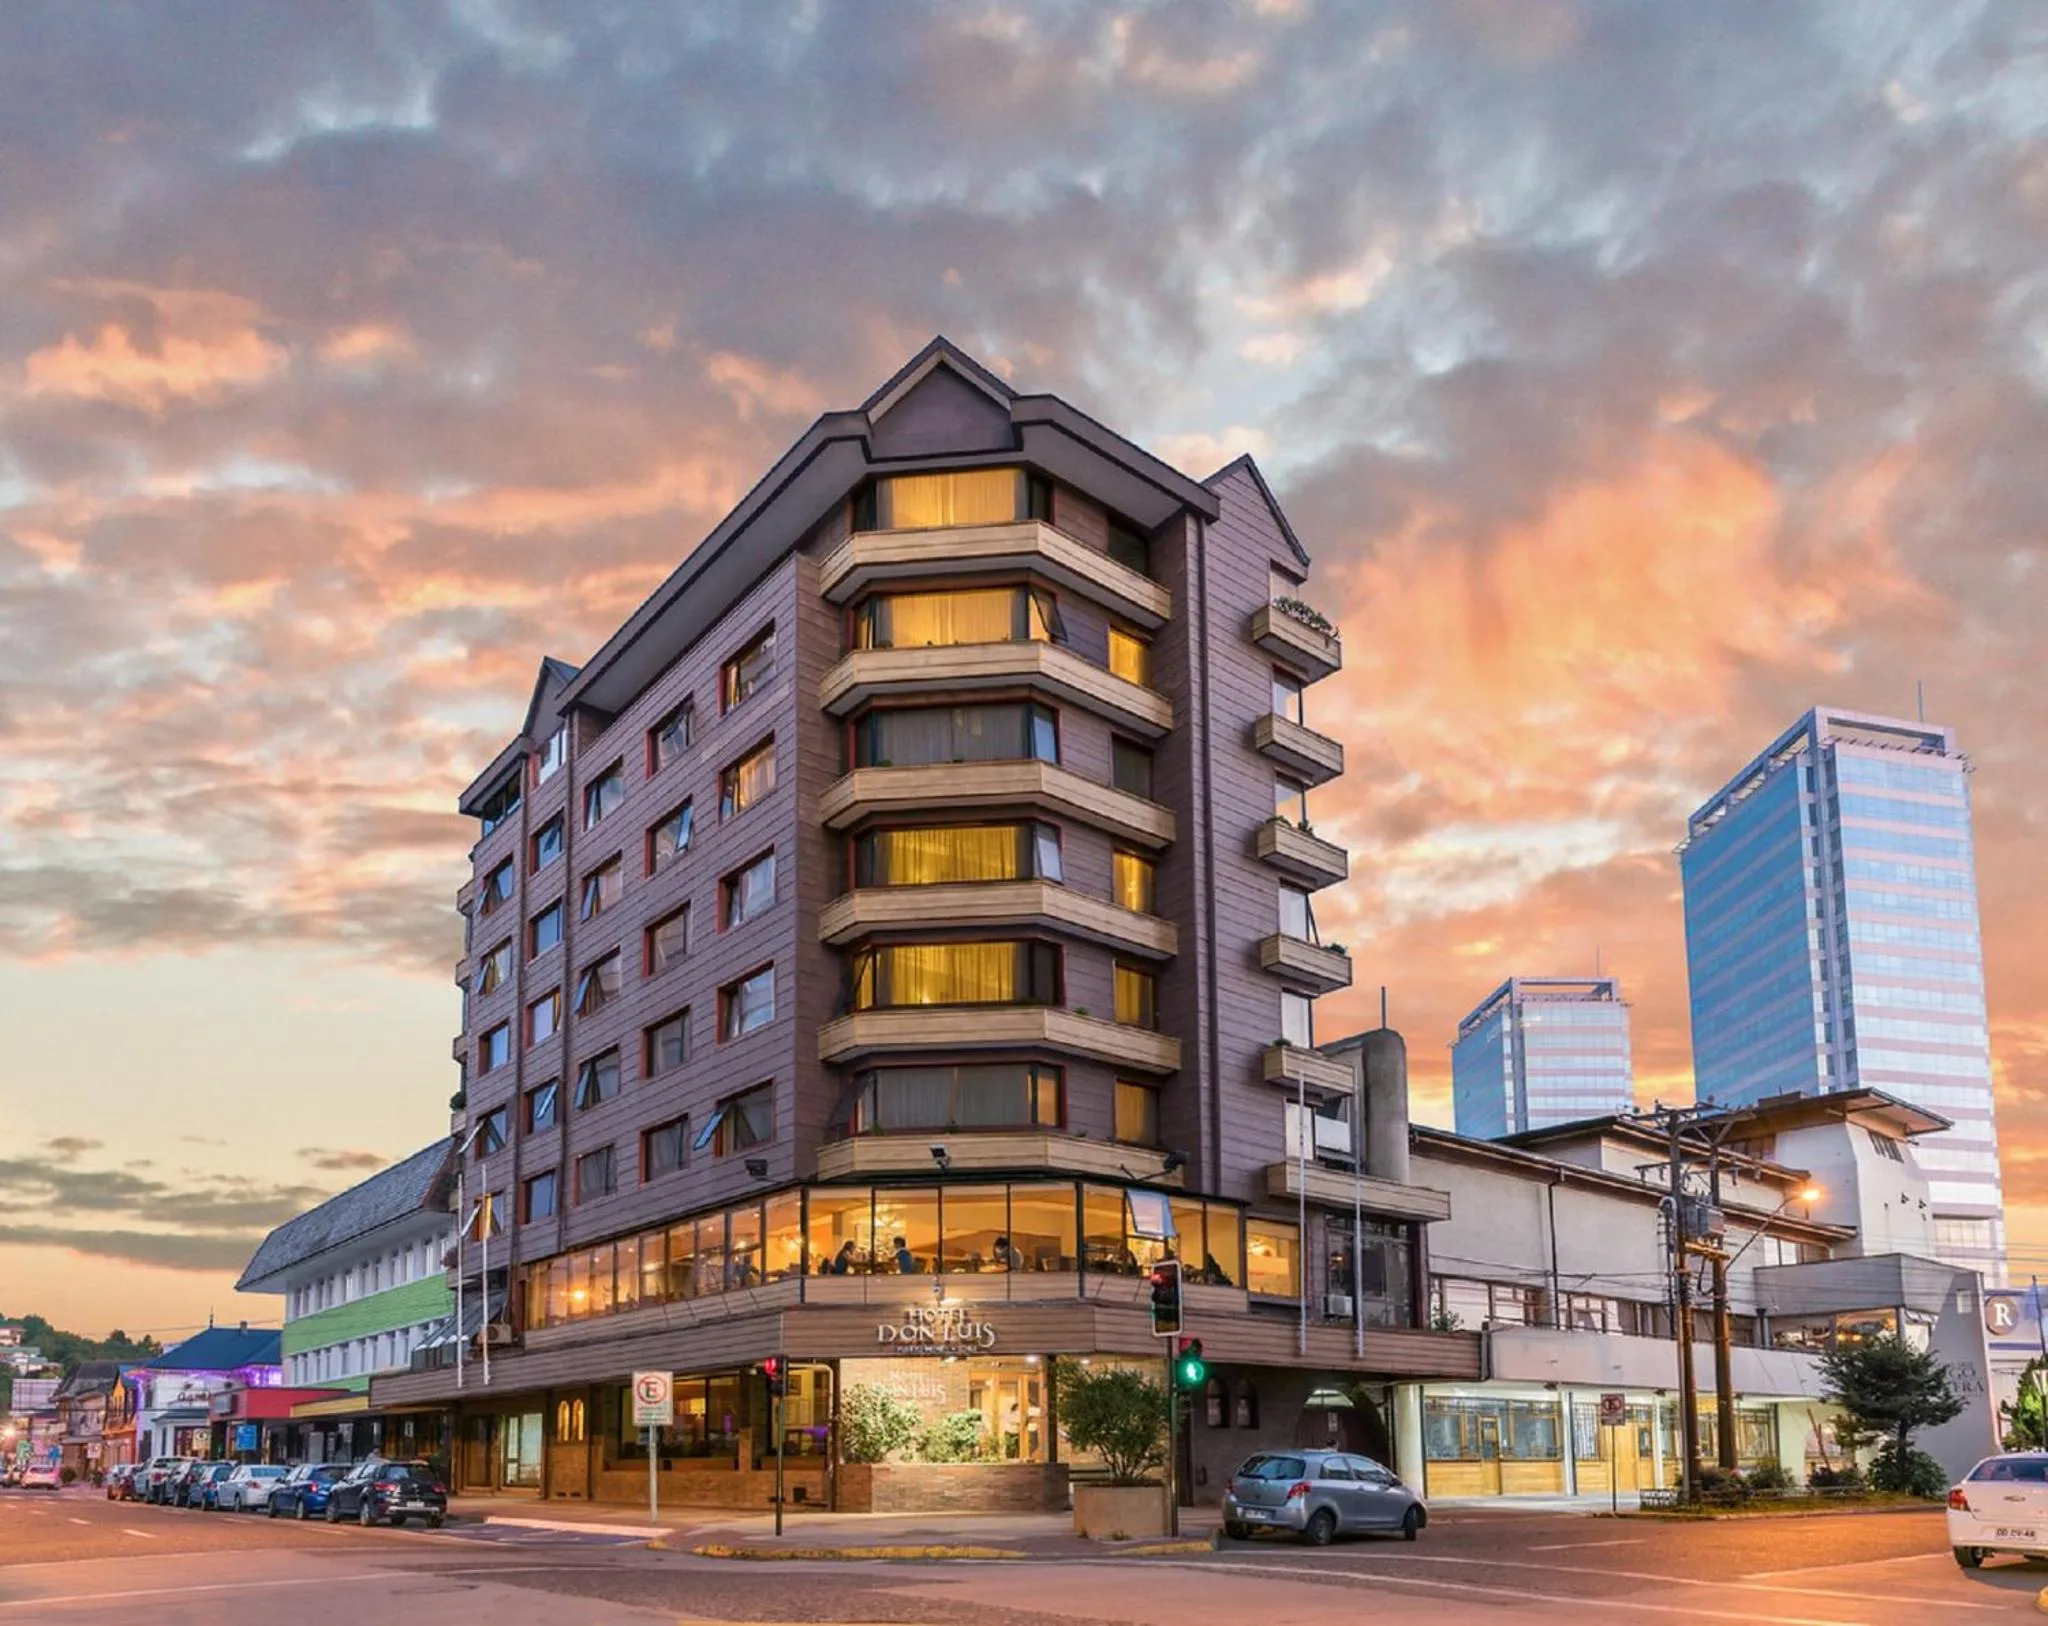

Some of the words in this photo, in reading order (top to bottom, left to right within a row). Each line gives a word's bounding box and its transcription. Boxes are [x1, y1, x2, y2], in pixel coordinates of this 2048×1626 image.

[909, 1307, 966, 1324] HOTEL
[1995, 1303, 2013, 1326] R
[878, 1324, 934, 1342] DON
[943, 1321, 996, 1348] LUIS
[645, 1381, 658, 1398] E
